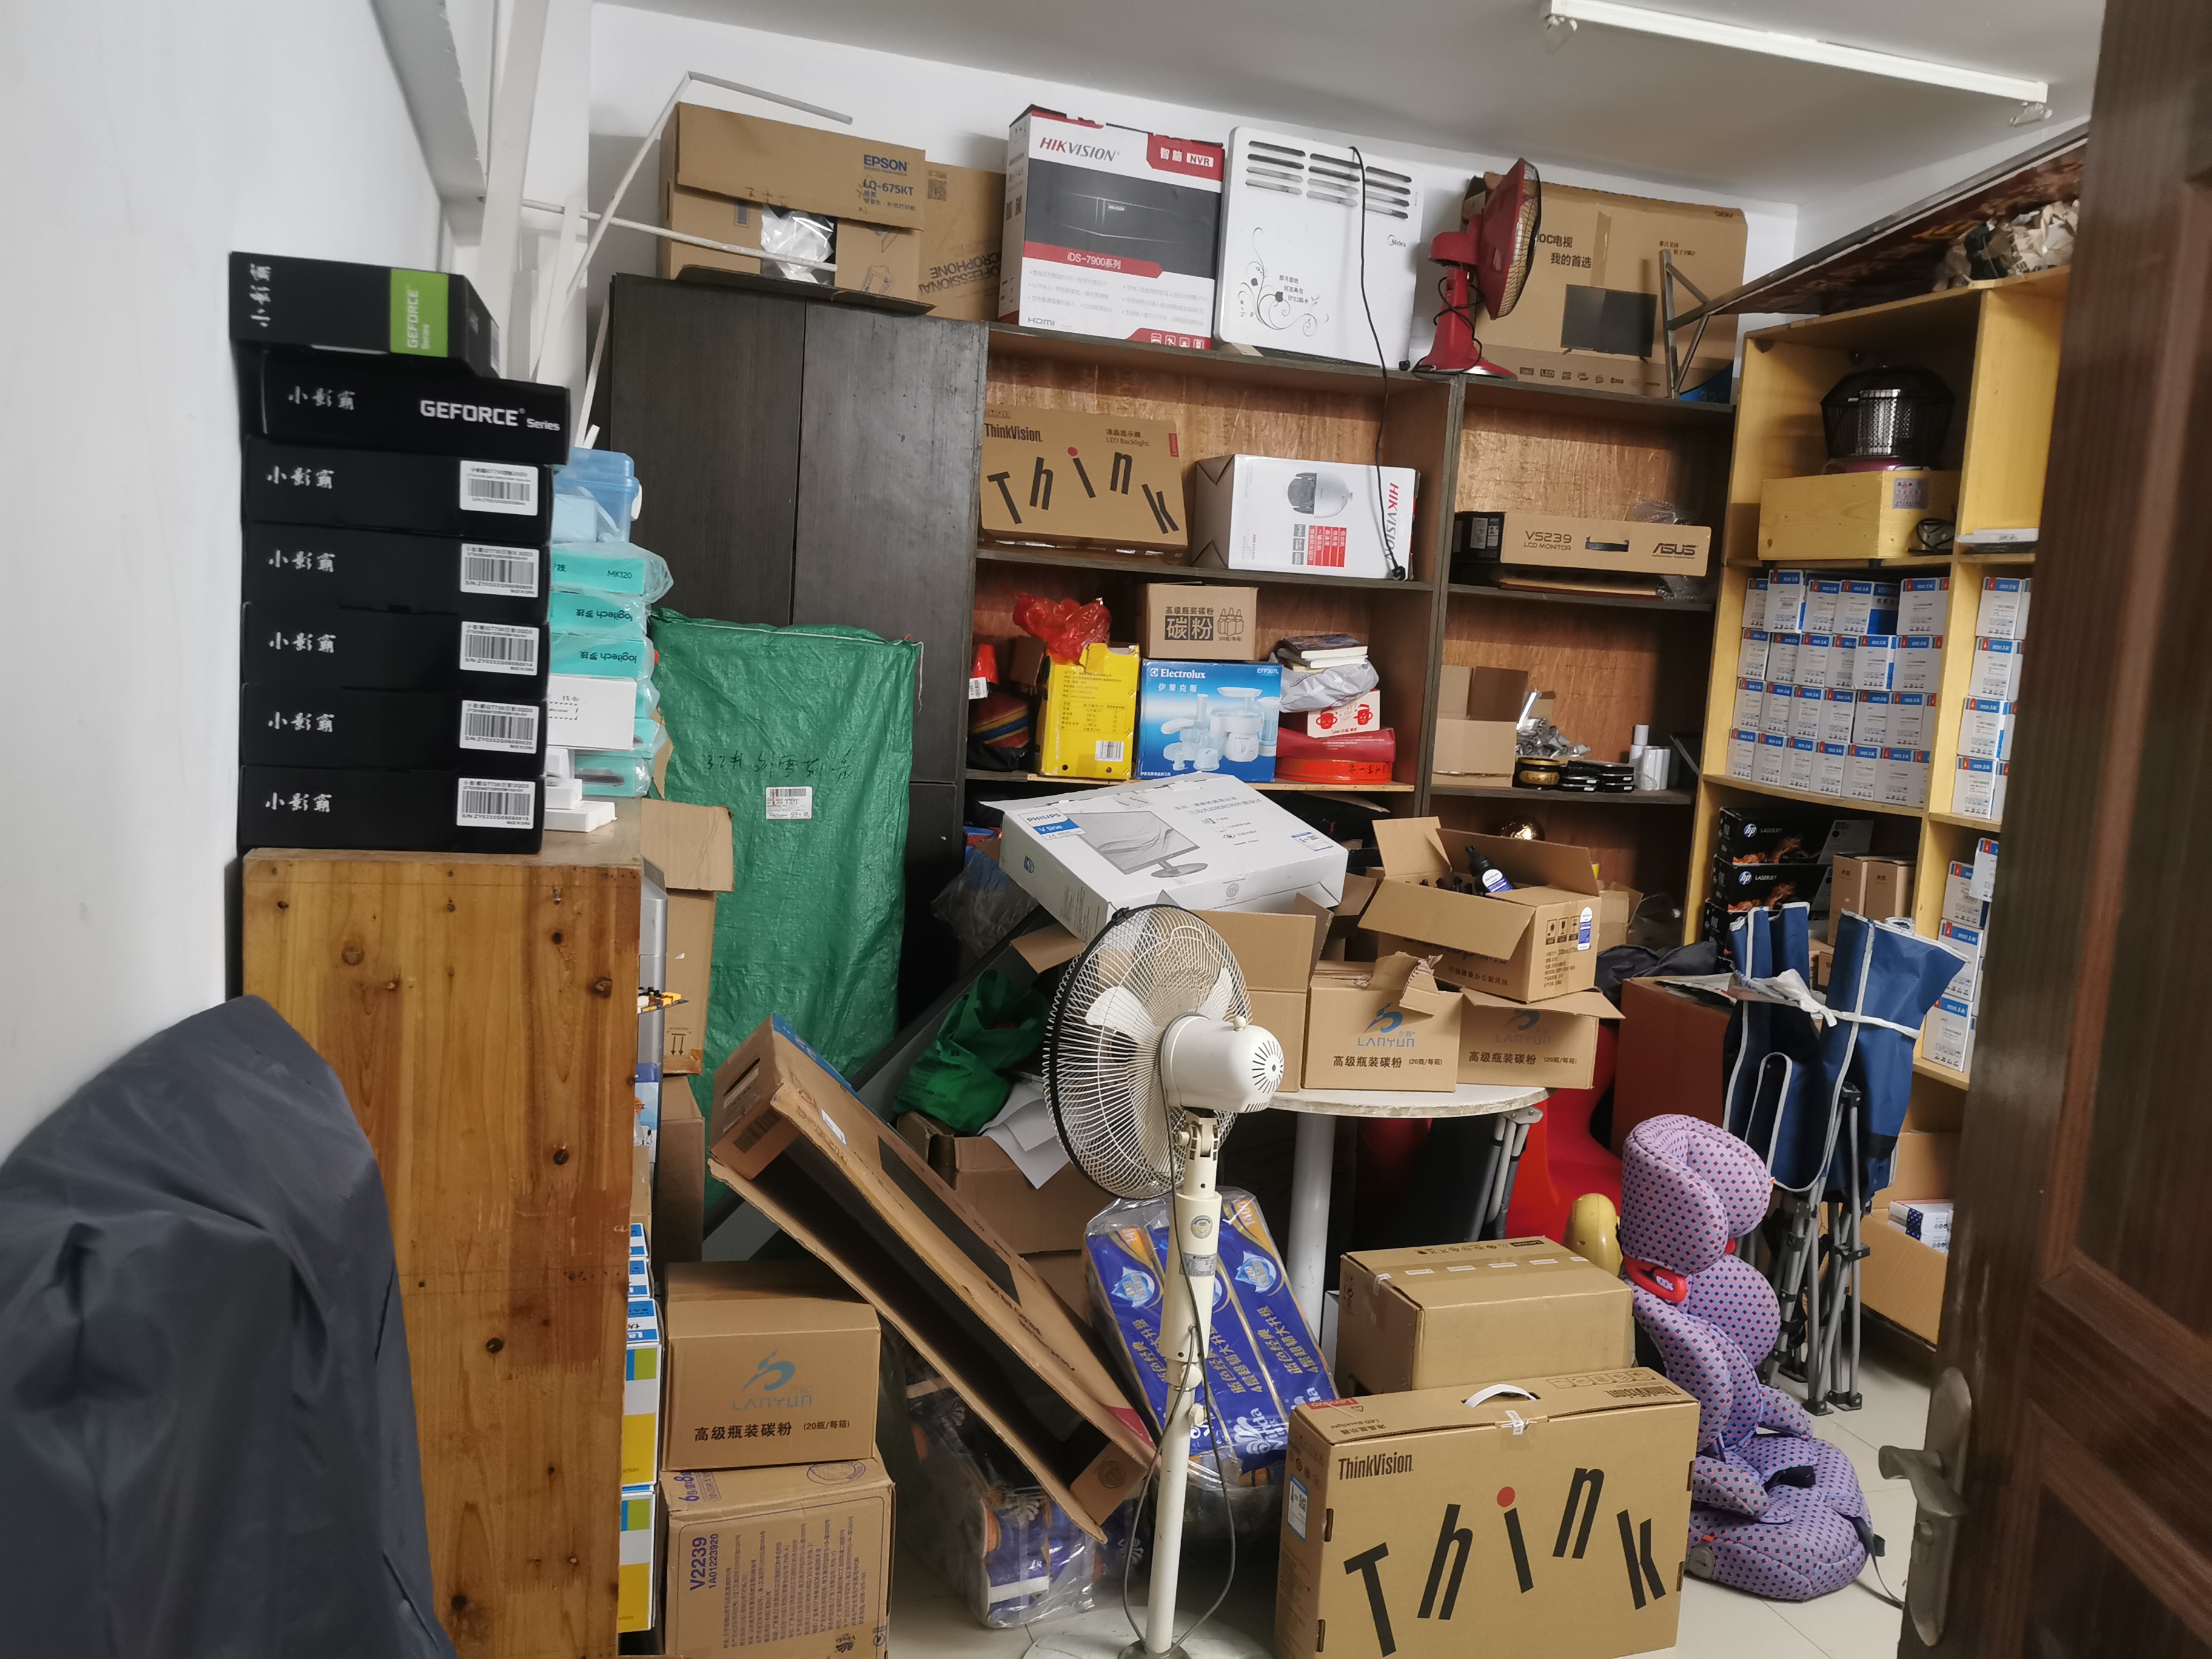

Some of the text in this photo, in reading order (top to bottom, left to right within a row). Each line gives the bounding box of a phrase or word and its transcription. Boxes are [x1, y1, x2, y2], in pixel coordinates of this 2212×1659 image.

[1039, 137, 1116, 162] HIKVISION
[863, 154, 908, 172] EPSON
[1189, 154, 1210, 166] NVR
[863, 179, 914, 196] LQ-675KT
[1538, 233, 1573, 248] OC电视
[930, 251, 1001, 280] CROPHONE
[1067, 252, 1122, 270] iDS-7900系列
[1550, 252, 1592, 269] 我的首选
[407, 290, 419, 348] GEFORCE
[1028, 317, 1056, 326] HDMI
[288, 386, 356, 411] 小影霸
[420, 400, 561, 431] GEFORCE Series
[984, 423, 1043, 442] ThinkVision
[1106, 428, 1141, 438] 液晶显示器
[1120, 438, 1150, 447] Backlight
[267, 465, 335, 489] 小影霸
[987, 446, 1180, 534] Think
[1525, 531, 1572, 544] VS239
[1653, 543, 1697, 555] ASUS
[269, 550, 335, 572] 小影霸
[607, 570, 632, 578] MK120
[597, 609, 632, 622] logitech
[1165, 606, 1214, 615] 高级瓶装碳粉
[1165, 617, 1213, 640] 碳粉
[269, 632, 336, 654] 小影霸
[600, 652, 637, 664] logitech
[1161, 668, 1205, 680] Electrolux
[268, 711, 335, 732] 小影霸
[266, 793, 332, 813] 小影霸
[1027, 813, 1061, 822] PHILIPS
[1746, 823, 1757, 837] hp
[1740, 871, 1752, 885] hp
[1358, 1037, 1415, 1047] LANYUN
[1495, 1034, 1552, 1044] LANYUN
[1333, 1056, 1402, 1068] 高级瓶装碳粉
[1469, 1051, 1537, 1065] 高级瓶装碳粉
[1256, 1304, 1319, 1373] 4层超韧大升级
[1258, 1328, 1303, 1375] 蓝色经典
[1603, 1384, 1681, 1399] ThinkVision
[732, 1395, 813, 1412] LANYUN
[694, 1419, 850, 1442] 高级瓶装碳粉 (20瓶/每箱)
[1250, 1407, 1284, 1450] Vinda
[1338, 1451, 1414, 1480] ThinkVision
[689, 1537, 708, 1591] V2239
[708, 1533, 719, 1589] 1A01223920
[1343, 1467, 1667, 1658] Think
